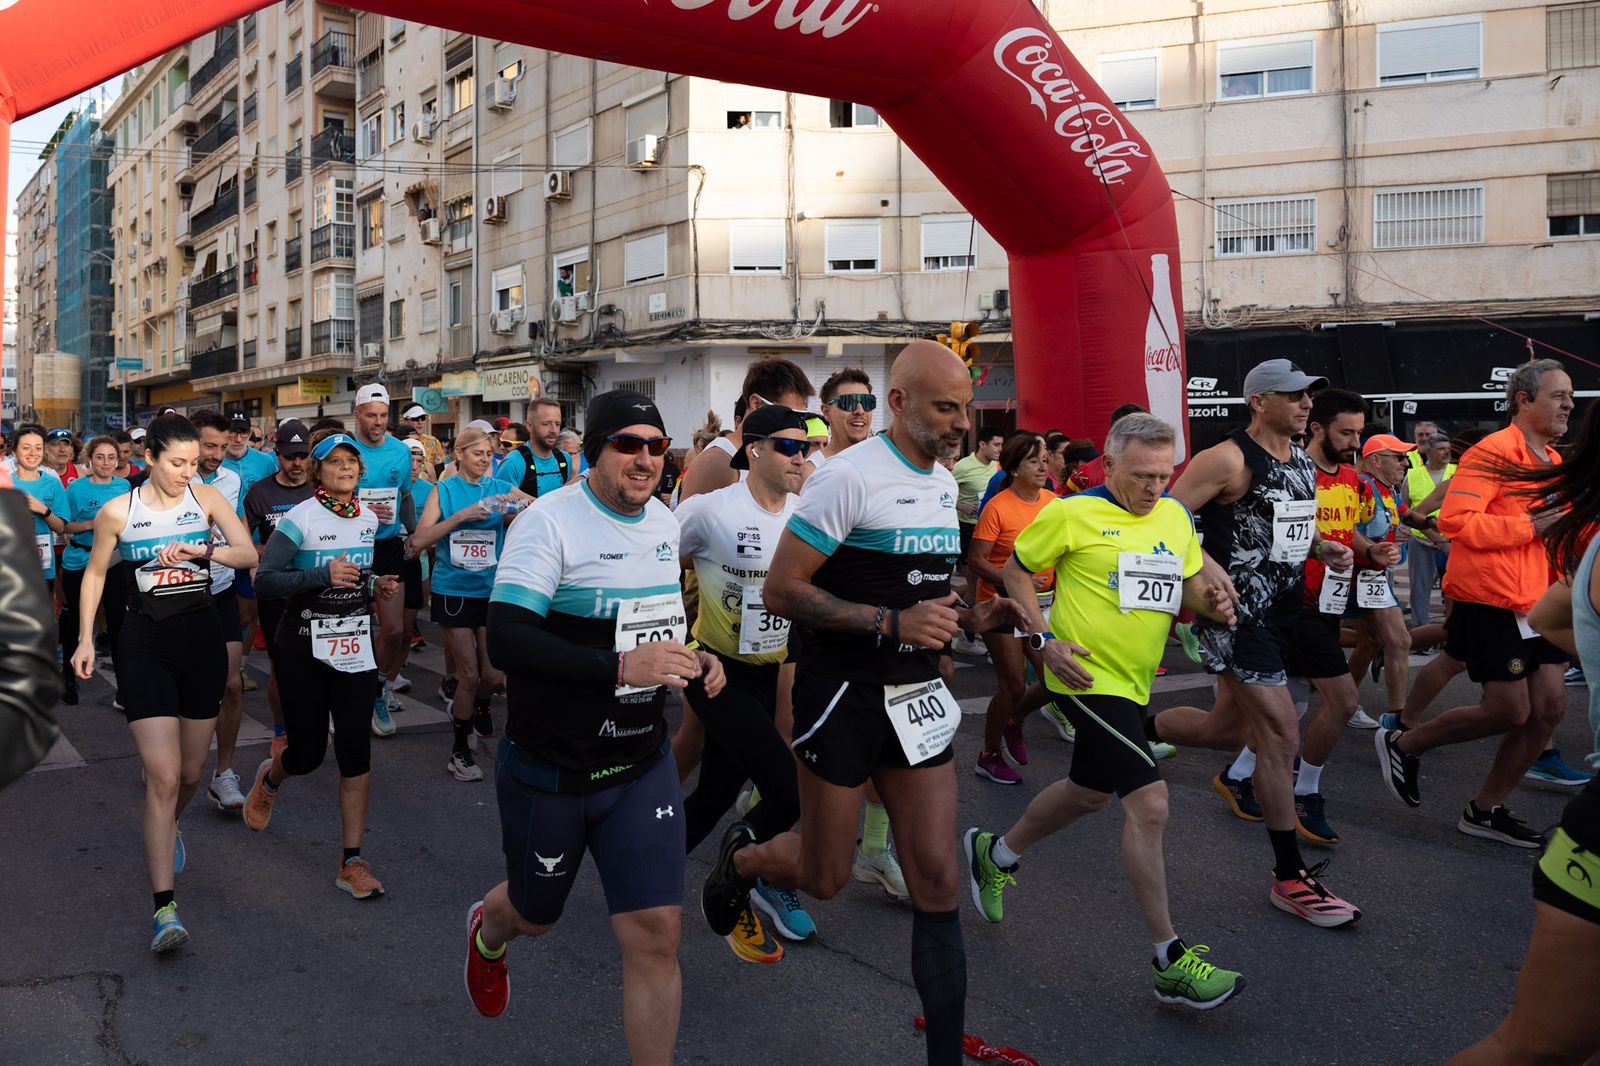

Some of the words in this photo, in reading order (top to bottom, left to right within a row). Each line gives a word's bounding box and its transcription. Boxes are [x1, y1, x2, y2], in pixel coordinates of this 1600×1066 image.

[993, 27, 1148, 185] Coca-Cola
[486, 370, 529, 387] MACARENO
[132, 520, 152, 529] vive
[1102, 528, 1121, 536] vive
[1286, 522, 1309, 542] 471
[319, 534, 337, 542] vive
[461, 545, 487, 558] 786
[152, 569, 194, 587] 768
[722, 564, 746, 578] CLUB
[1137, 579, 1175, 603] 207
[327, 637, 361, 656] 756
[907, 695, 946, 727] 440
